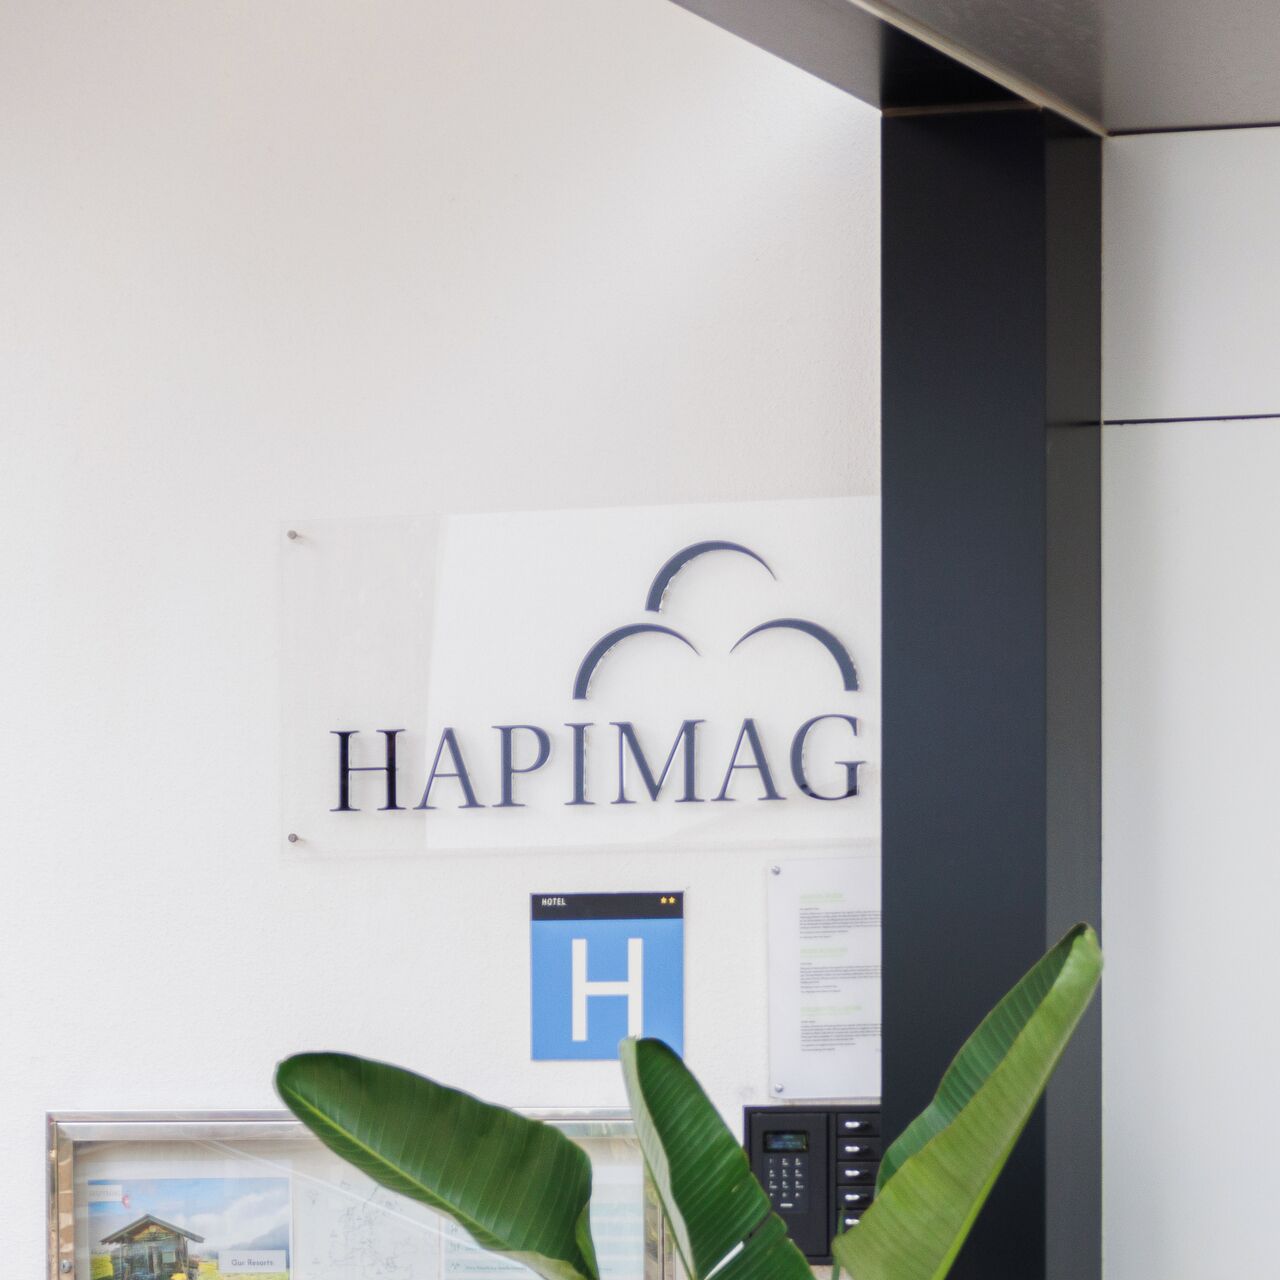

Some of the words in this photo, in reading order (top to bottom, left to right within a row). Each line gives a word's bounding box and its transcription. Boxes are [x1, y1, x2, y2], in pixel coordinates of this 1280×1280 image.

[330, 713, 867, 812] HAPIMAG
[541, 897, 567, 906] HOTEL
[571, 937, 644, 1042] H
[247, 1258, 274, 1267] Resorts
